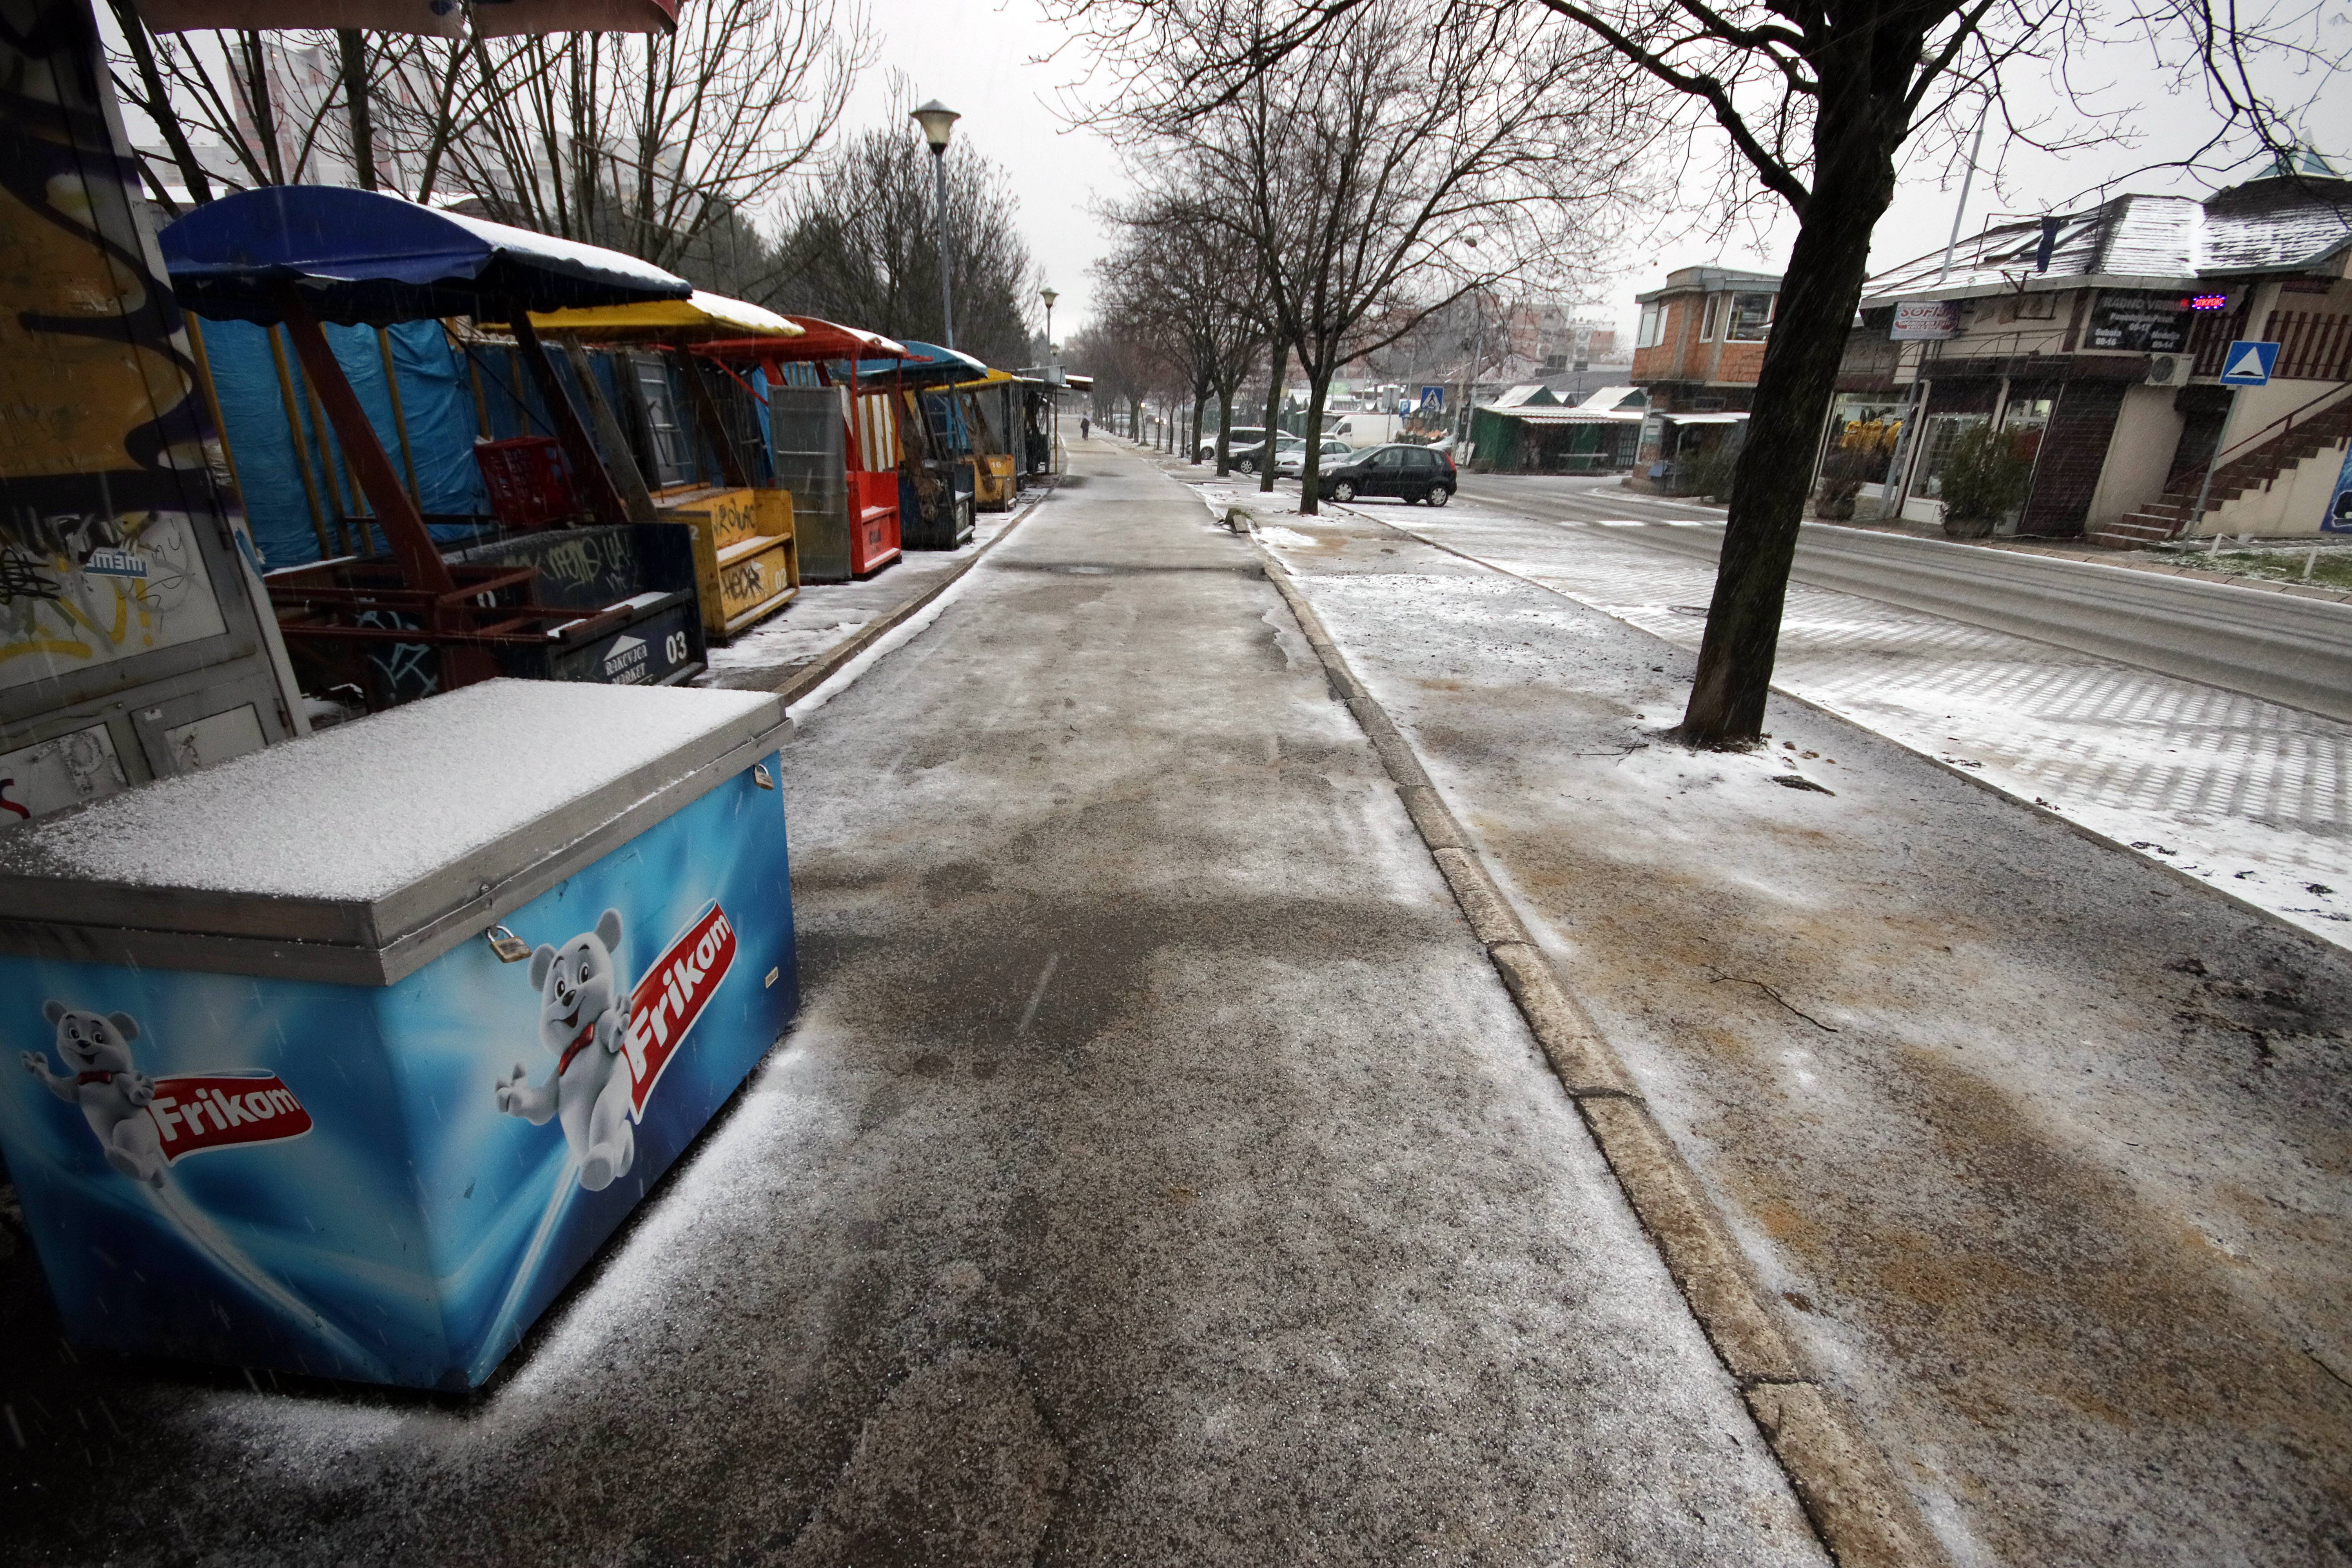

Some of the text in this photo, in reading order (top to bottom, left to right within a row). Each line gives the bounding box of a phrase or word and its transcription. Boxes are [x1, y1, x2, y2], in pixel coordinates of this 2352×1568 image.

[666, 631, 688, 664] 03
[624, 915, 731, 1084] Frikom
[147, 1087, 300, 1142] Frikom
